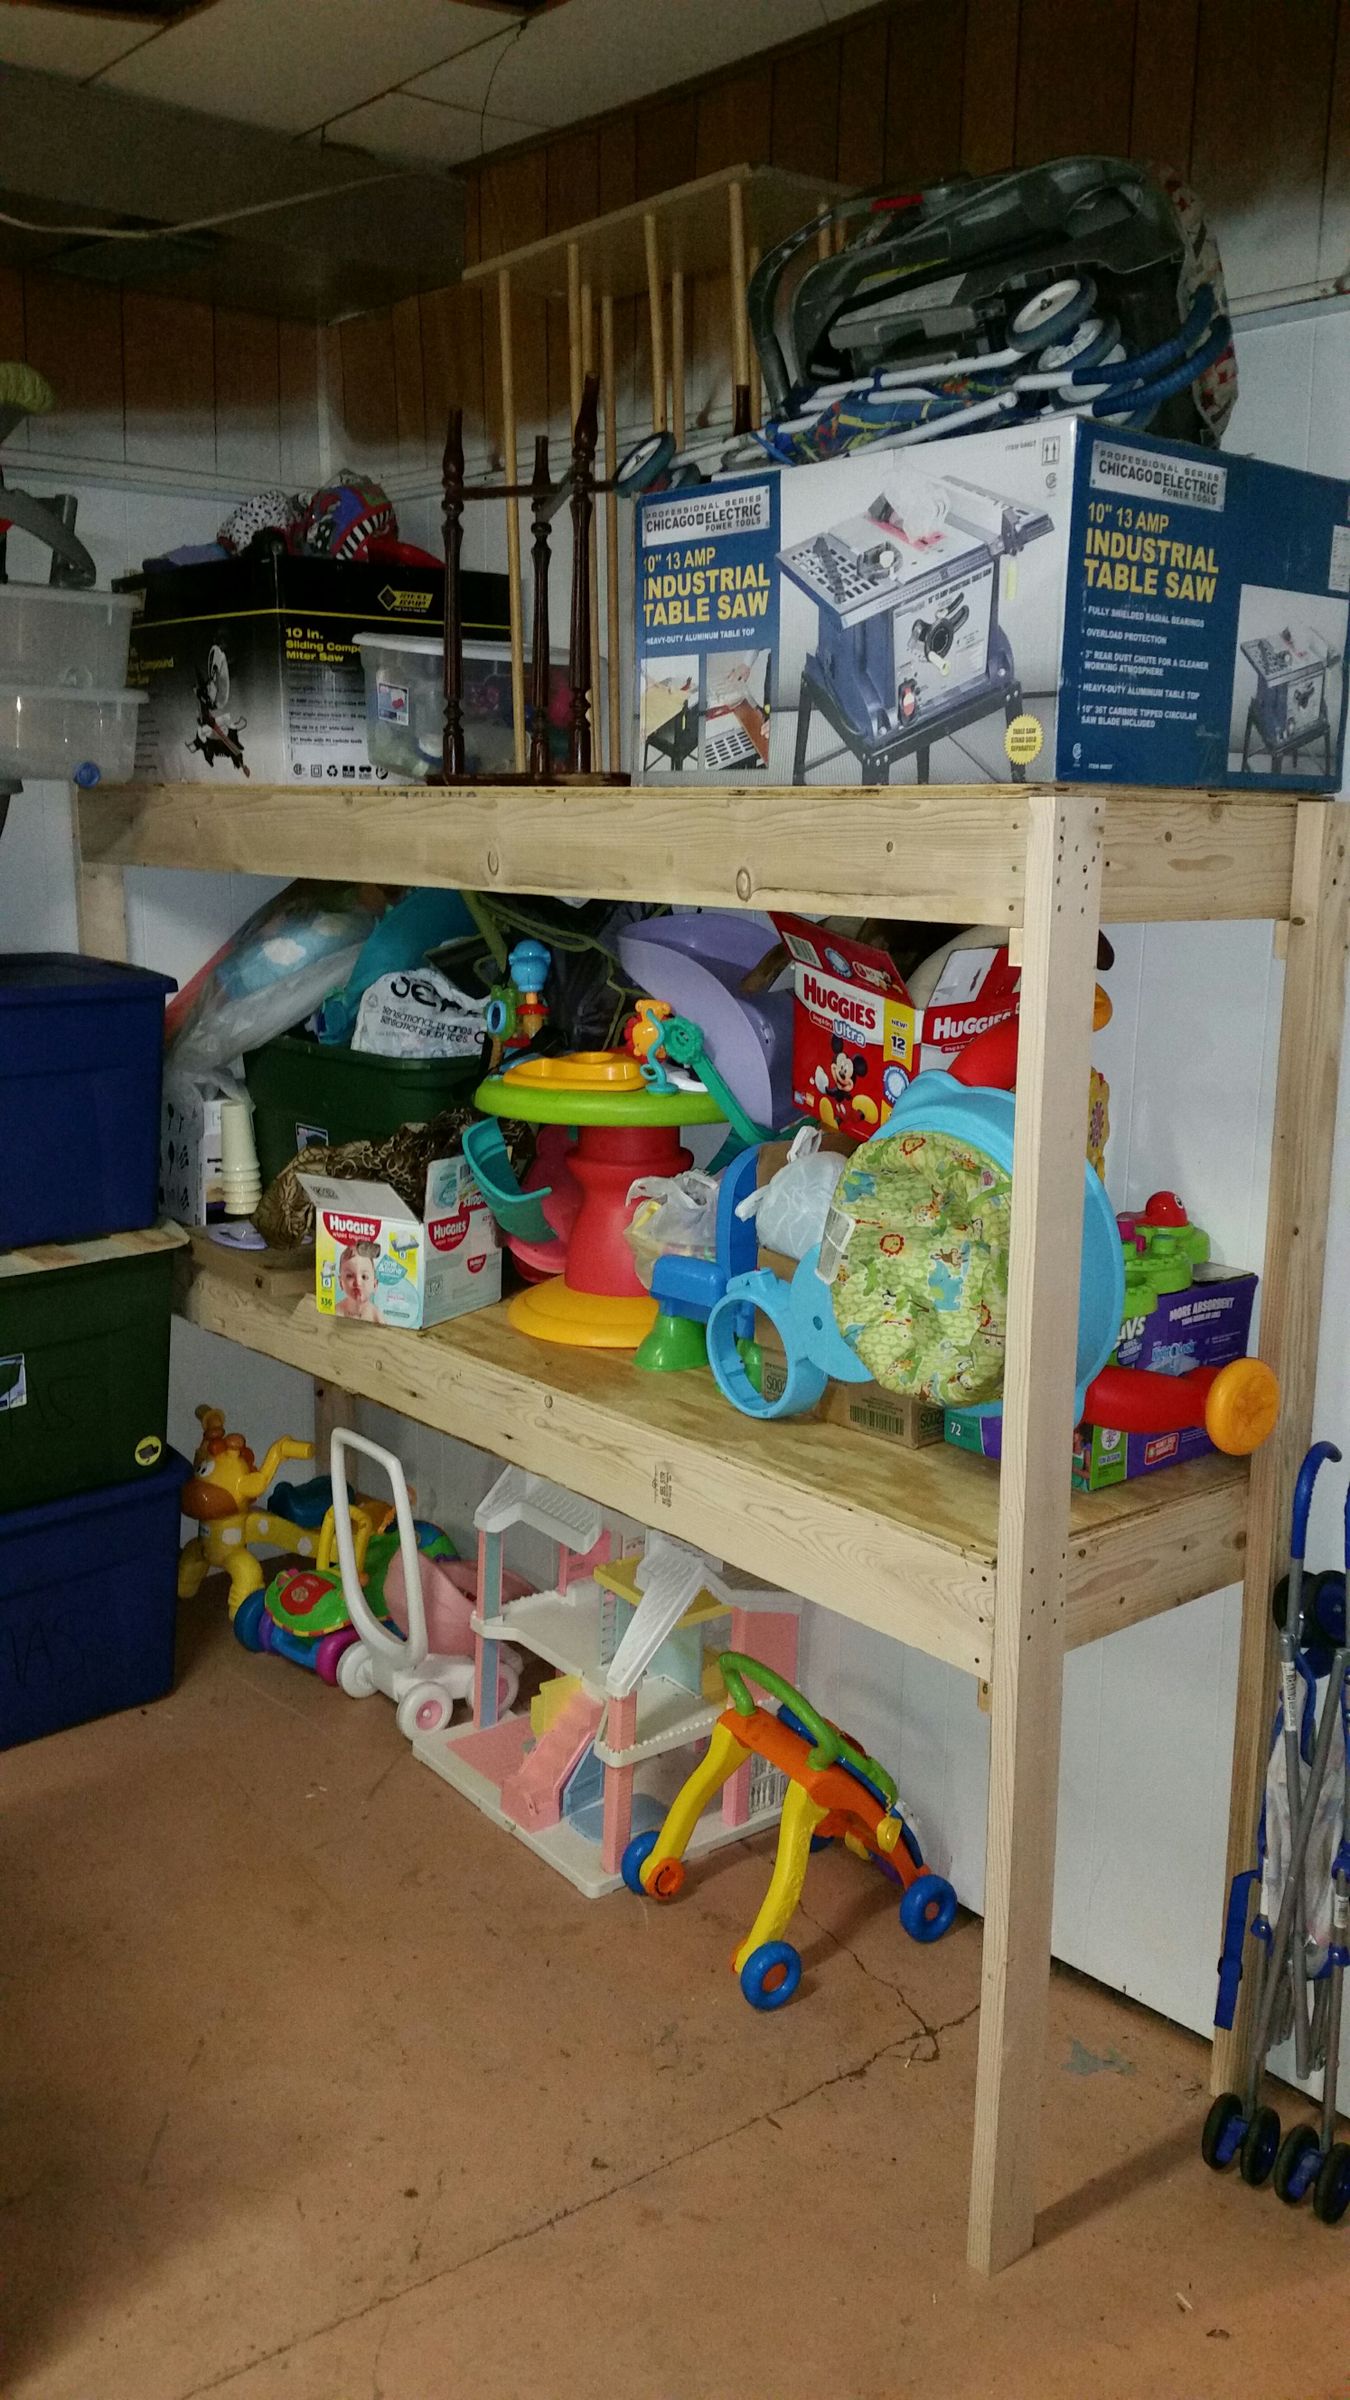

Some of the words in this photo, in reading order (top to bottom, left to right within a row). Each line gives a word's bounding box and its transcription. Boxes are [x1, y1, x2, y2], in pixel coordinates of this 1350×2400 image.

[1100, 450, 1179, 473] PROFESSIONAL
[1184, 467, 1220, 481] SERIES
[1099, 460, 1153, 483] CHICAGO
[1163, 473, 1218, 496] ELECTRIC
[646, 502, 719, 519] PROFESSIONAL
[725, 494, 761, 507] SERIES
[1162, 487, 1189, 499] POWER
[1191, 493, 1217, 505] TOOLS
[646, 514, 695, 533] CHICAGO
[705, 504, 761, 523] ELECTRIC
[705, 522, 732, 532] POWER
[736, 518, 761, 527] TOOLS
[1088, 501, 1112, 524] 10"
[1116, 507, 1133, 529] 13
[1135, 510, 1169, 534] AMP
[666, 551, 680, 570] 13
[684, 547, 716, 568] AMP
[1085, 527, 1219, 574] INDUSTRIAL
[643, 563, 771, 600] INDUSTRIAL
[1084, 558, 1159, 596] TABLE
[1165, 571, 1216, 604] SAW
[643, 597, 710, 627] TABLE
[717, 590, 769, 620] SAW
[1088, 605, 1110, 617] FULLY
[1111, 608, 1145, 620] SHIELDED
[1171, 616, 1205, 628] BEARINGS
[285, 627, 303, 638] 10
[685, 631, 719, 642] ALUMINUM
[720, 629, 740, 639] TABLE
[742, 627, 755, 636] TOP
[1086, 627, 1123, 640] OVERLOAD
[1124, 631, 1168, 645] PROTECTION
[285, 640, 325, 652] Sliding
[286, 651, 316, 661] Miter
[319, 652, 344, 662] Saw
[1084, 661, 1118, 672] WORKING
[1119, 664, 1165, 676] ATMOSPHERE
[1094, 650, 1113, 661] REAR
[1114, 652, 1133, 662] DUST
[1134, 654, 1157, 665] CHUTE
[1158, 656, 1171, 666] FOR
[1172, 658, 1178, 666] A
[1179, 659, 1209, 670] CLEANER
[1082, 683, 1126, 694] HEAVY-DUTY
[1127, 686, 1164, 697] ALUMINUM
[1165, 689, 1186, 699] TABLE
[1187, 690, 1200, 700] TOP
[1081, 715, 1097, 725] SAW
[1098, 716, 1120, 726] BLADE
[1121, 718, 1156, 728] INCLUDED
[1109, 706, 1138, 716] CARBIDE
[1139, 708, 1163, 719] TIPPED
[1164, 710, 1198, 720] CIRCULAR
[803, 973, 876, 1030] HUGGIES
[834, 1019, 865, 1046] Ultra
[891, 1035, 905, 1051] 12
[329, 1214, 376, 1236] HUGGIES
[433, 1220, 467, 1240] HUGGIES
[1169, 1303, 1192, 1322] MORE
[1192, 1297, 1235, 1315] ABSORBENT
[950, 1422, 961, 1436] 72
